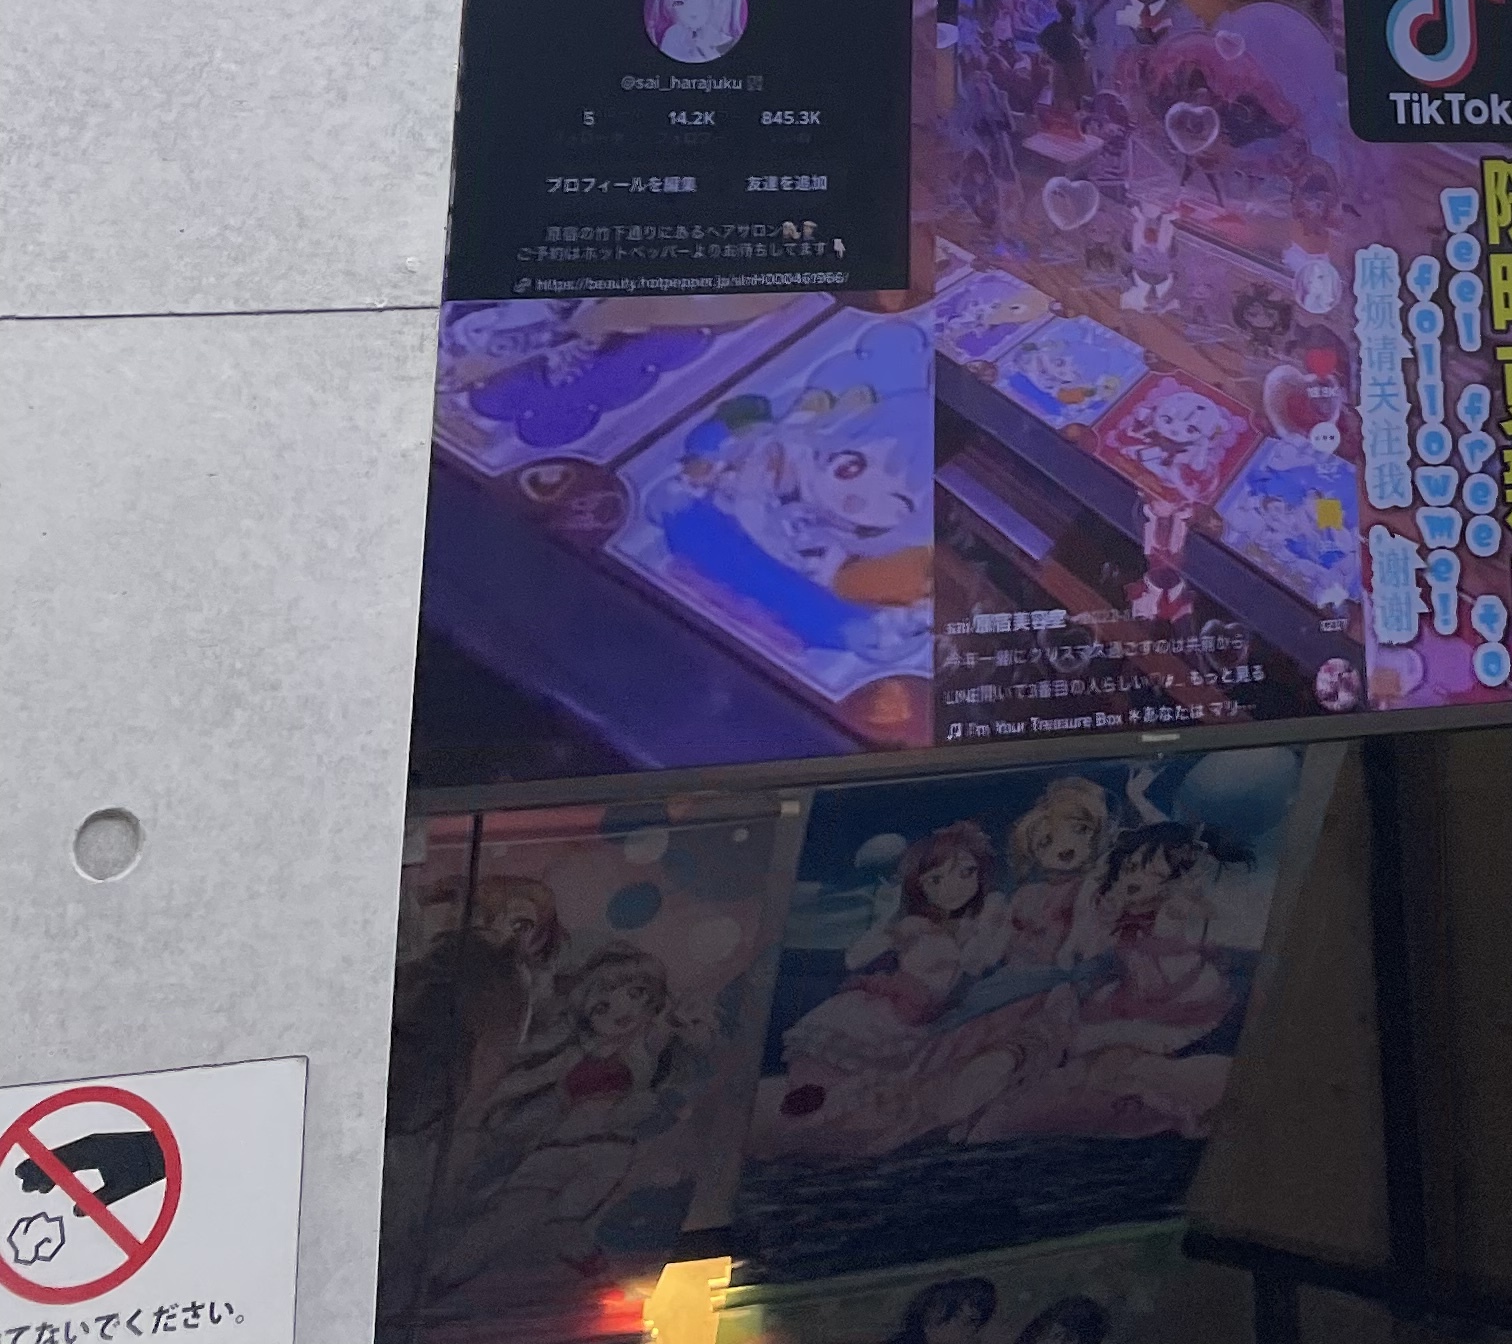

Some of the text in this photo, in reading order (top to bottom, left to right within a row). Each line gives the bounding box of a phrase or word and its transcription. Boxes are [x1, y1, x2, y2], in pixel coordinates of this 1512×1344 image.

[582, 110, 821, 127] 5 14.2K 845.3K
[0, 1300, 245, 1344] てないでください。
